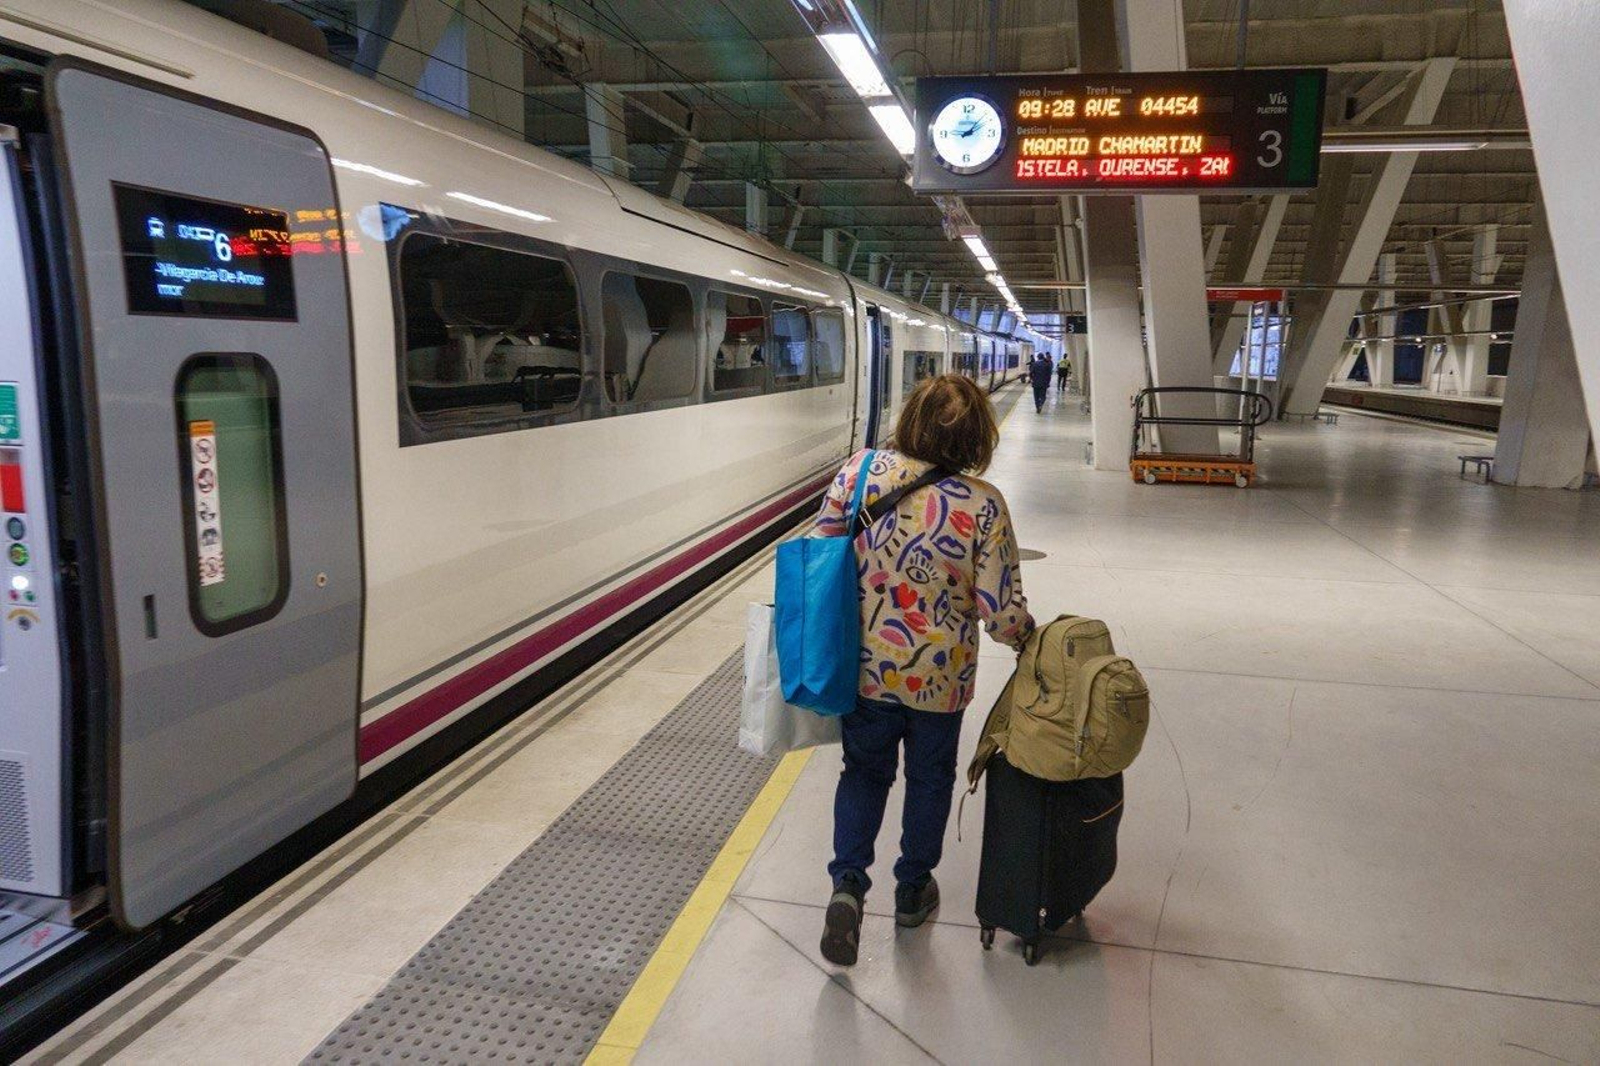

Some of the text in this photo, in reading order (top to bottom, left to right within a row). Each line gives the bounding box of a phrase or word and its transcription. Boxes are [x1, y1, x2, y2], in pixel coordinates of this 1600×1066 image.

[1019, 87, 1041, 97] Hora
[1086, 85, 1108, 95] Tren
[962, 104, 976, 114] 12
[1018, 96, 1199, 118] 09:28 AVE 04454
[939, 130, 948, 139] 9
[987, 128, 996, 138] 3
[1016, 126, 1047, 136] Destino
[1022, 134, 1203, 156] MADRID CHAMARTIN
[1256, 129, 1283, 168] 3
[962, 153, 971, 163] 6
[214, 232, 232, 262] 6
